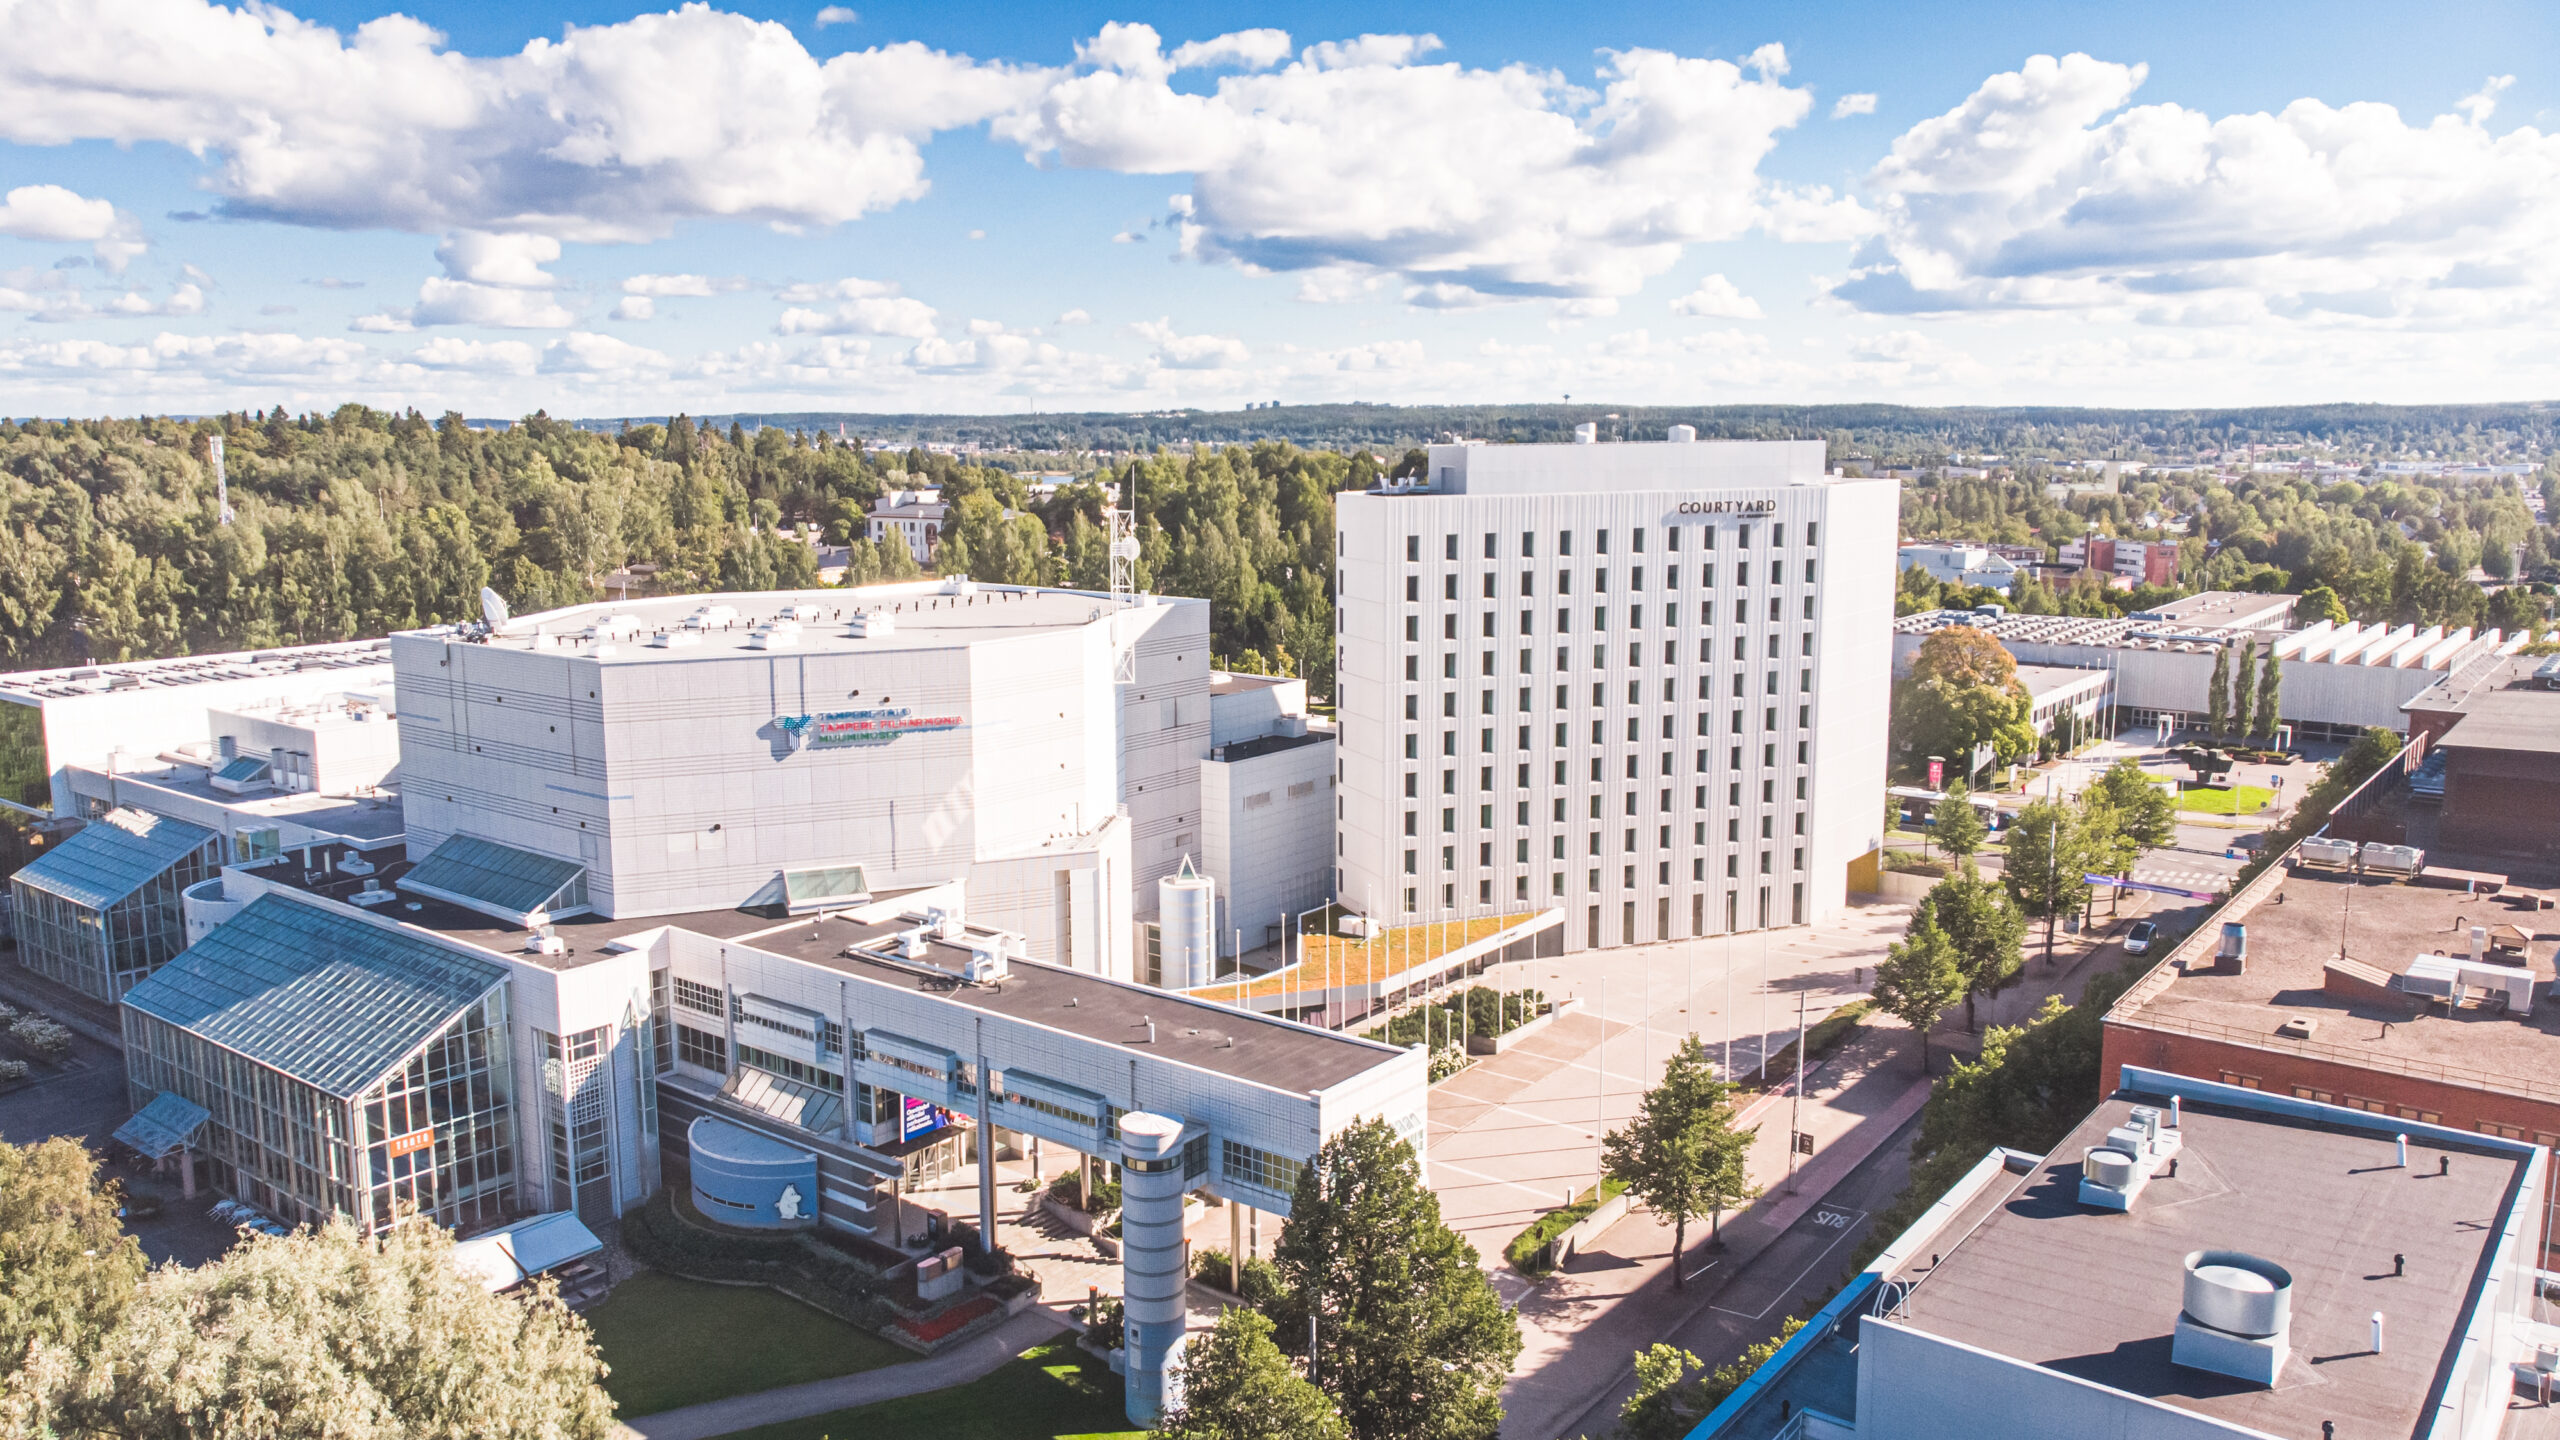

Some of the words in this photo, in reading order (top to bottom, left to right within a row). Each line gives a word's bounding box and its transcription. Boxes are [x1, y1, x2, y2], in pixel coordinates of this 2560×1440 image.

[1679, 500, 1776, 514] COURTYARD
[820, 722, 875, 733] TAMPERE
[881, 716, 963, 729] FILHARMONIA
[1812, 1211, 1851, 1228] BUS
